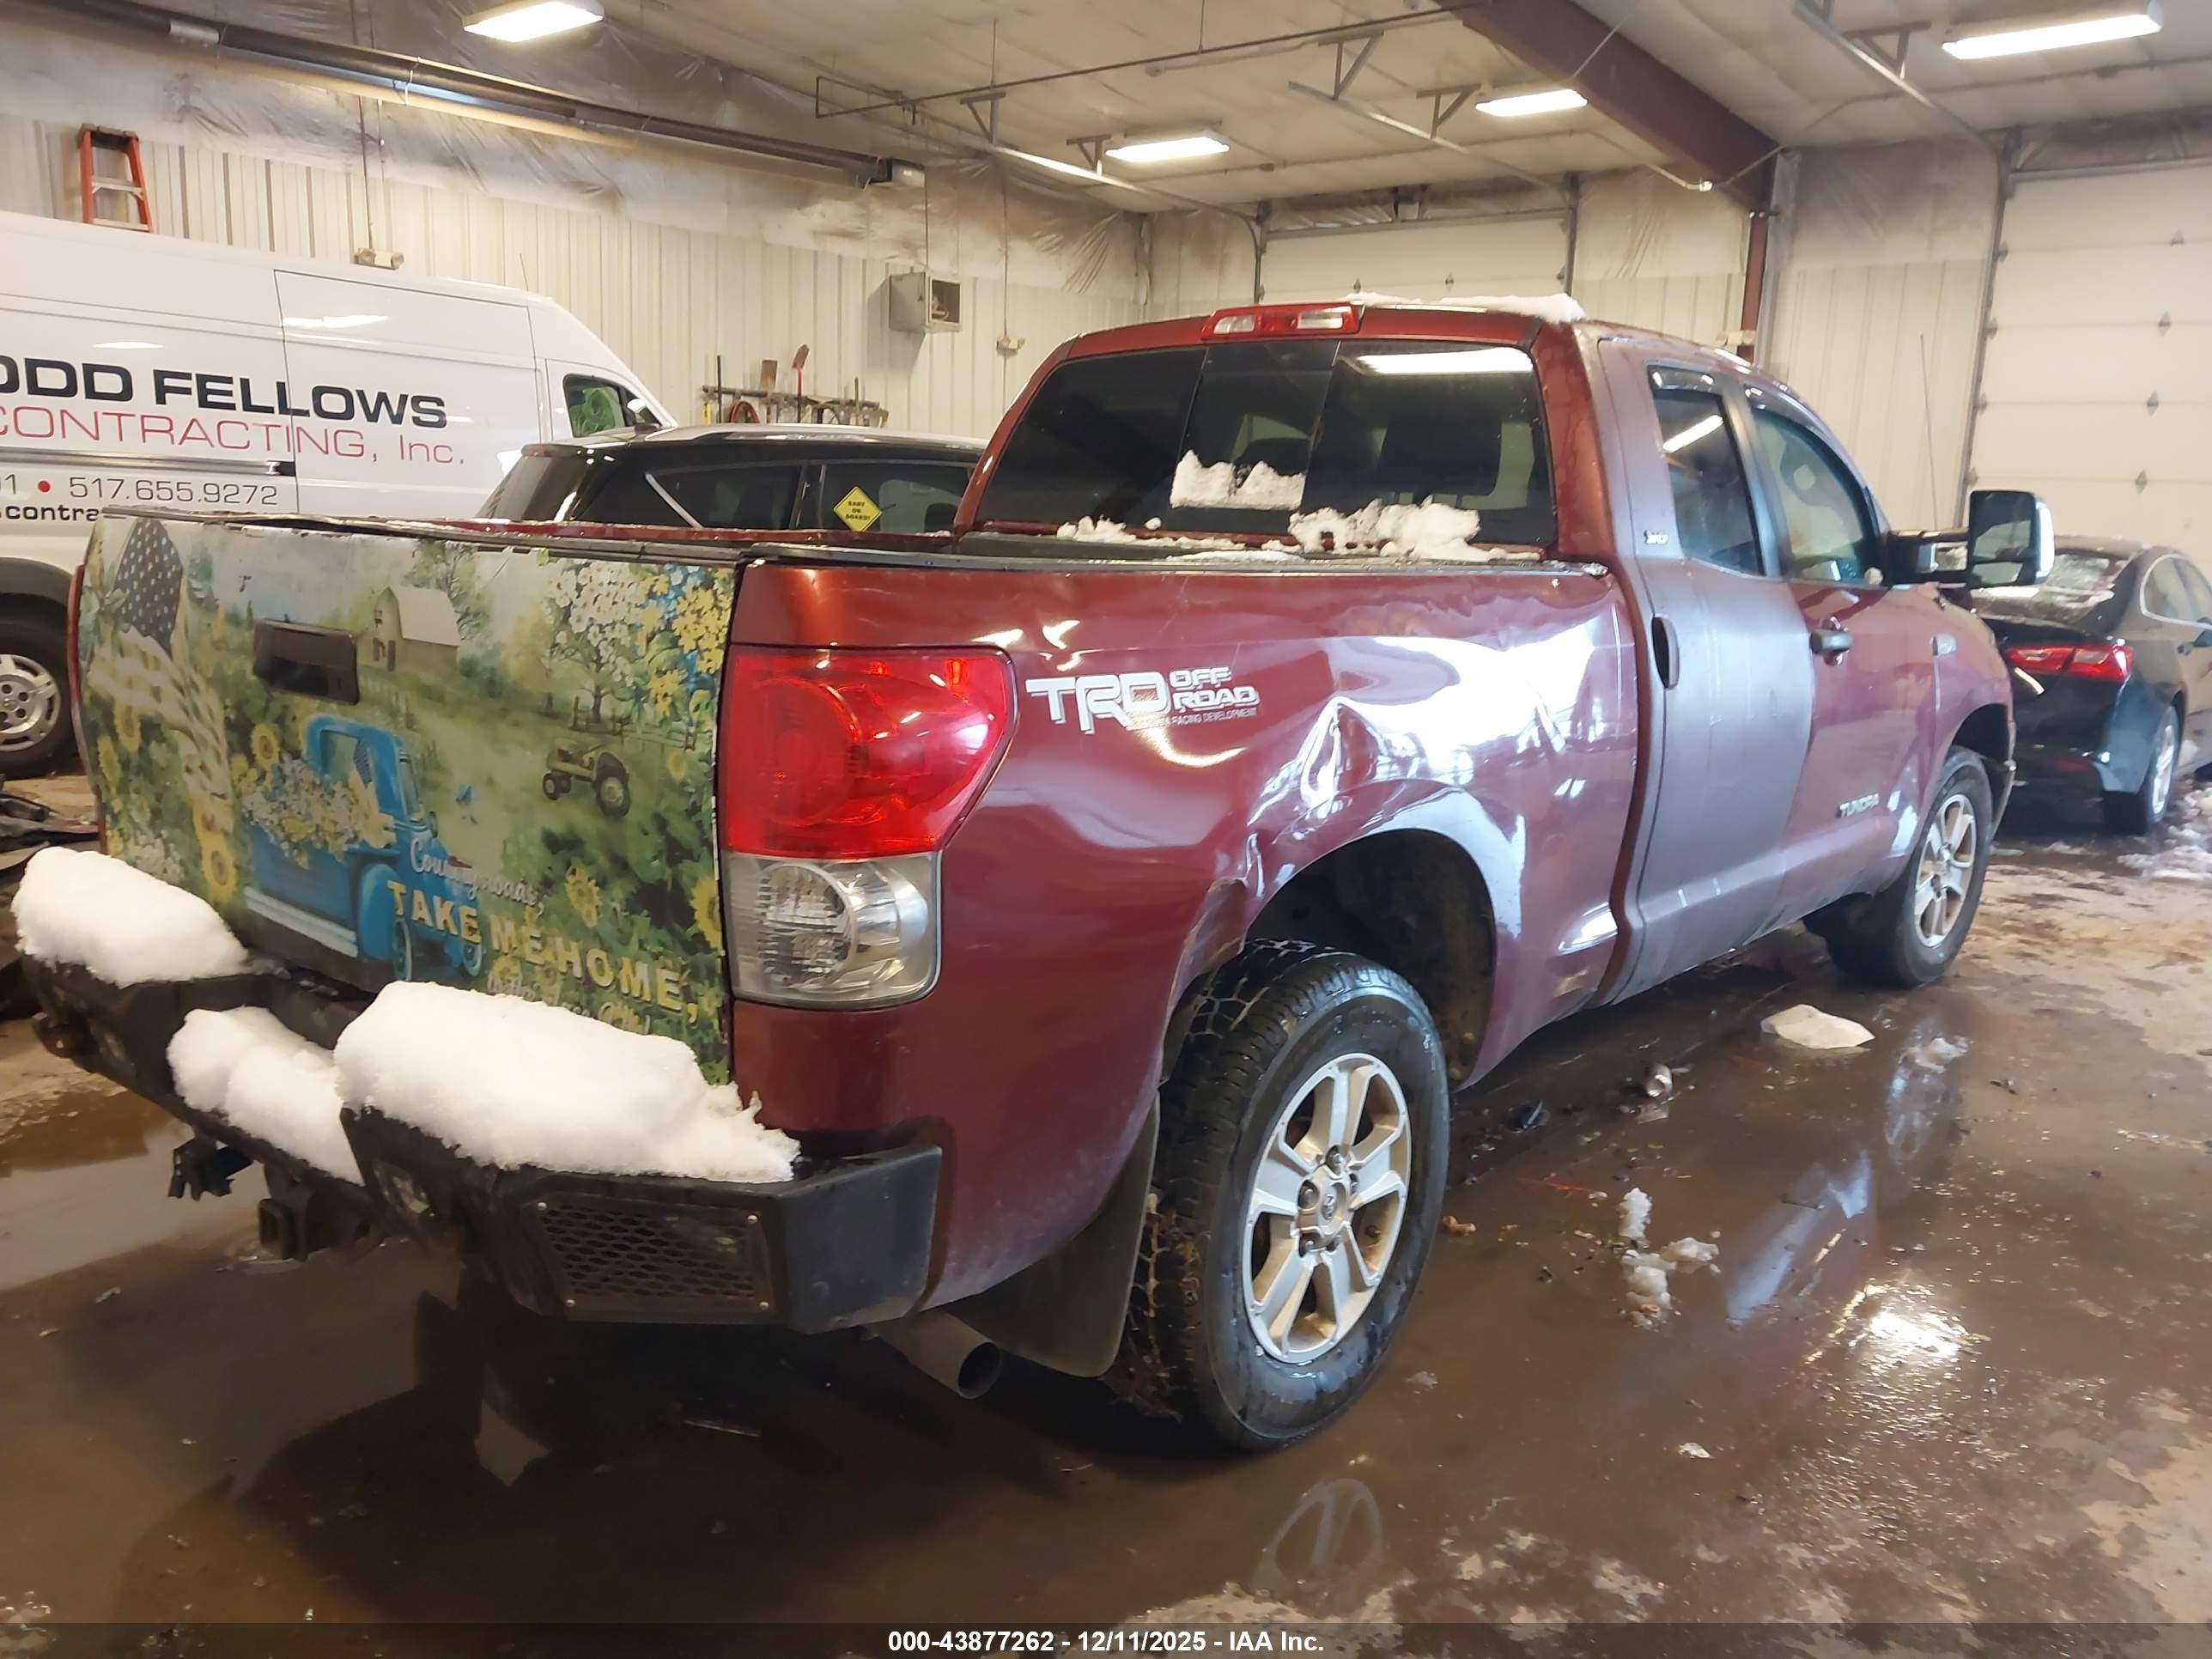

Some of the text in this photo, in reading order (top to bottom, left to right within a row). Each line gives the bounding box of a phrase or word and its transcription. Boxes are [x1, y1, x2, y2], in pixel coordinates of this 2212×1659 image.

[153, 368, 447, 428] FELLOWS
[0, 405, 465, 465] ONTRACTING, Inc.
[69, 477, 279, 507] 517.655.9272
[1025, 671, 1170, 734] TRD
[1169, 666, 1233, 690] OFF
[1172, 685, 1261, 714] ROAD
[386, 880, 483, 945] TAKE
[489, 913, 546, 966] ME
[556, 936, 698, 1024] HOME,
